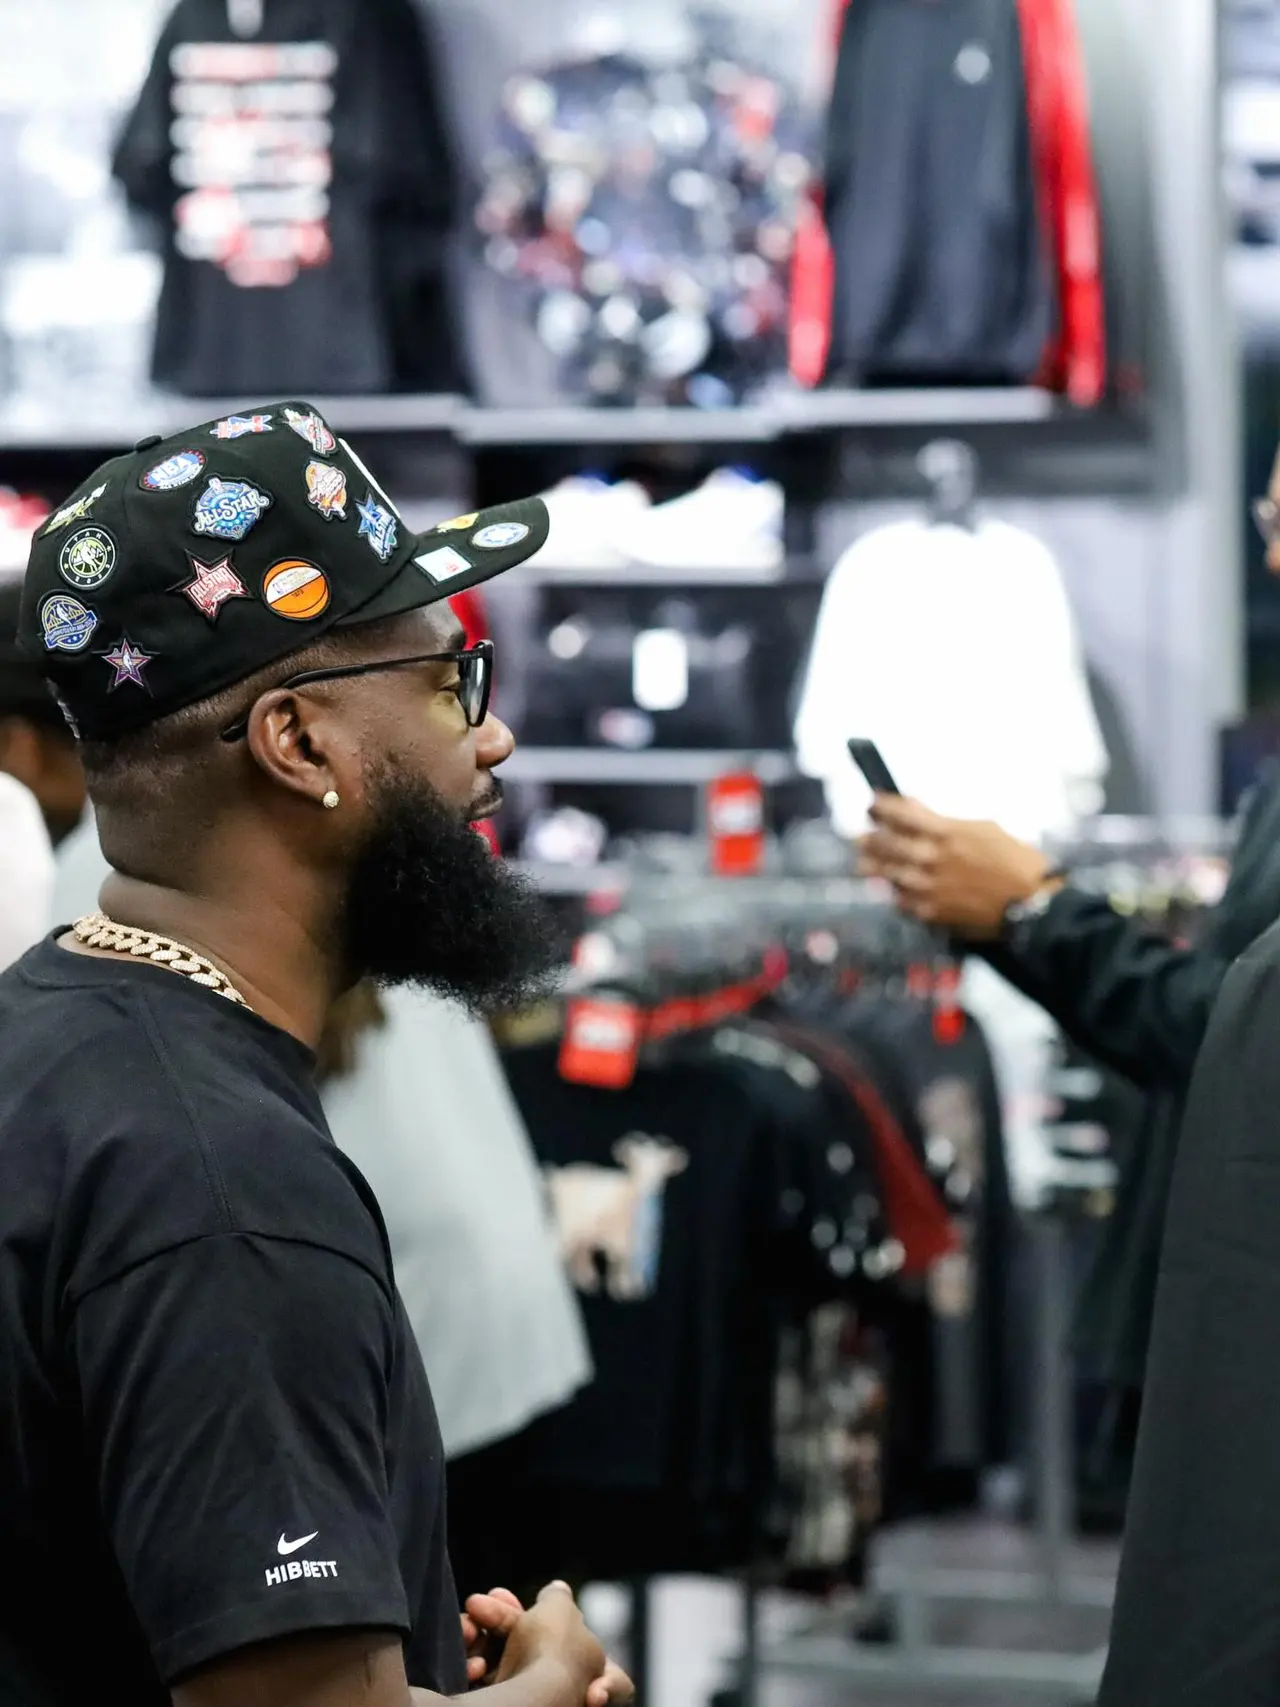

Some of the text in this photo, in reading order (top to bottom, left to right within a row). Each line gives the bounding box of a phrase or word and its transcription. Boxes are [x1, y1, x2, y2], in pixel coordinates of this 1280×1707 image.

[150, 456, 193, 484] NBA
[64, 531, 102, 553] UTAH
[265, 1560, 338, 1587] HIBBETT
